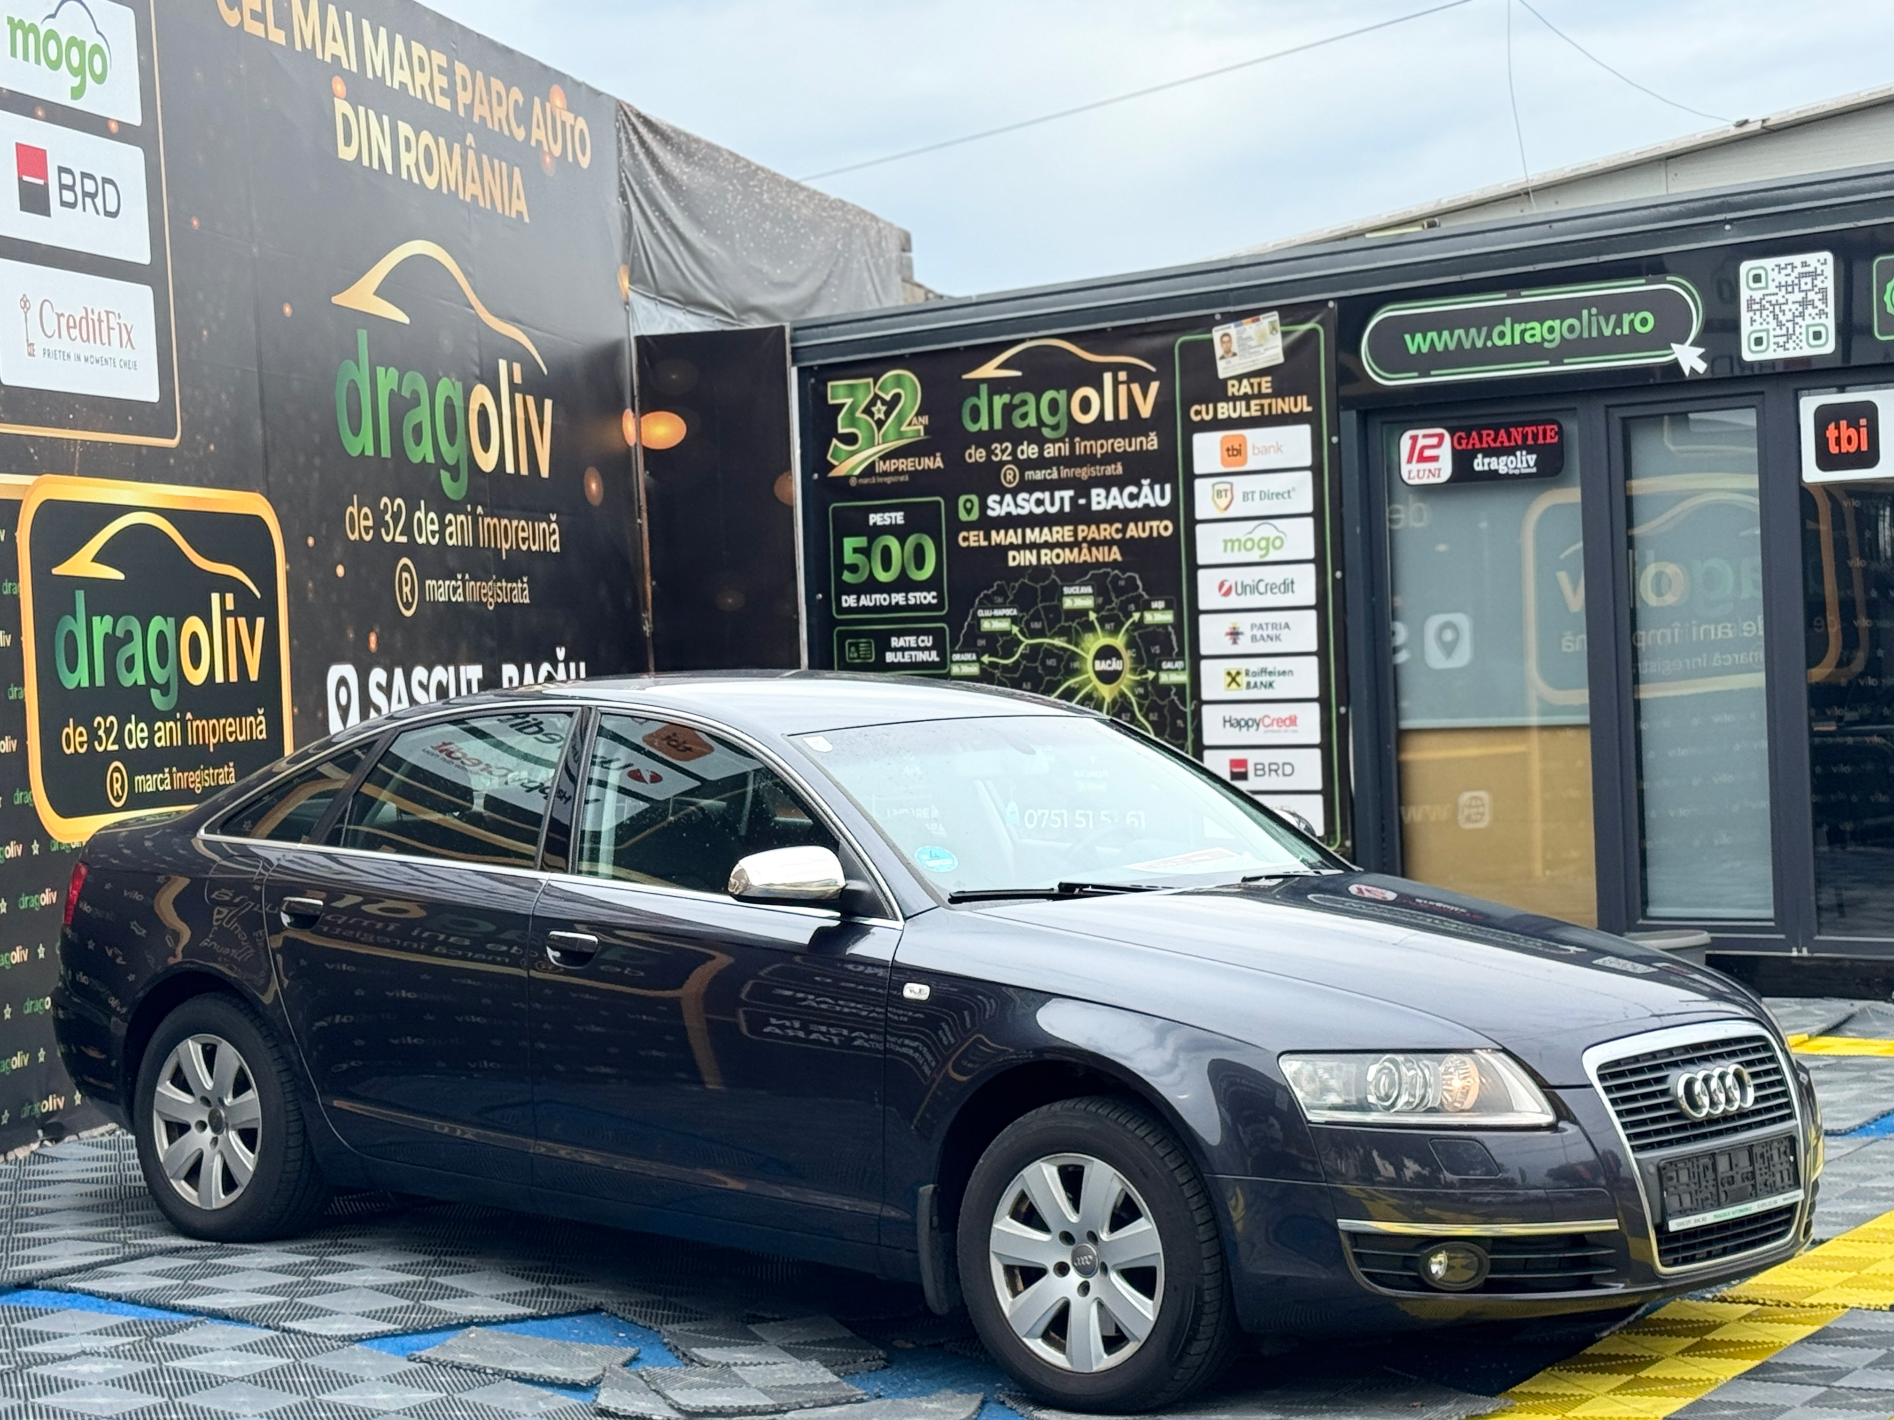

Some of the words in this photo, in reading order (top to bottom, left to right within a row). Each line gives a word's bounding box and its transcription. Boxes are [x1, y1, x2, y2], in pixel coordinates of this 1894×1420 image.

[7, 16, 108, 100] mogo
[291, 0, 358, 73] MAI
[362, 18, 451, 111] MARE
[455, 60, 526, 142] PARC
[530, 96, 591, 169] AUTO
[334, 96, 393, 175] DIN
[398, 133, 530, 223] ROMÂNIA
[57, 165, 122, 219] BRD
[39, 298, 136, 350] CreditFix
[1404, 307, 1655, 355] www.dragoliv.ro
[42, 347, 71, 361] PRIETEN
[73, 352, 81, 362] IN
[84, 354, 117, 368] MOMENTE
[119, 358, 138, 371] CHEIE
[1227, 376, 1272, 397] RATE
[335, 328, 553, 500] dragoliv
[961, 371, 1160, 439] dragoliv
[1190, 403, 1213, 422] CU
[1217, 395, 1312, 420] BULETINUL
[826, 368, 924, 466] 32
[911, 415, 929, 426] ANI
[965, 445, 987, 463] de
[991, 442, 1013, 461] 32
[1017, 441, 1039, 459] de
[1043, 439, 1070, 458] ani
[1075, 431, 1159, 457] împreună
[1452, 424, 1559, 450] GARANTIE
[1826, 418, 1869, 454] tbi
[1225, 444, 1243, 458] tbi
[1252, 441, 1283, 456] bank
[1405, 433, 1444, 465] 12
[875, 452, 944, 474] ÎMPREUNĂ
[1025, 466, 1058, 481] marcă
[1060, 462, 1123, 481] înregistrată
[1407, 467, 1442, 481] LUNI
[1473, 451, 1538, 474] dragoliv
[986, 489, 1074, 517] SASCUT
[1090, 479, 1172, 511] BACĂU
[1216, 489, 1230, 500] BT
[1242, 491, 1256, 502] BT
[345, 494, 374, 543] de
[380, 495, 408, 544] 32
[413, 499, 440, 546] de
[445, 502, 474, 548] ani
[477, 503, 561, 561] împreună
[869, 512, 904, 526] PESTE
[958, 531, 988, 547] CEL
[991, 528, 1023, 546] MAI
[1025, 526, 1075, 544] MARE
[1078, 523, 1123, 541] PARC
[1125, 520, 1173, 539] AUTO
[1008, 550, 1038, 567] DIN
[1040, 543, 1122, 566] ROMÂNIA
[1222, 534, 1284, 559] mogo
[841, 533, 937, 584] 500
[425, 573, 464, 603] marcă
[465, 575, 531, 611] înregistrată
[1063, 586, 1093, 595] SUCEAVA
[1234, 578, 1295, 596] UniCredit
[841, 595, 857, 607] DE
[859, 594, 889, 606] AUTO
[891, 593, 905, 605] PE
[906, 592, 938, 604] STOC
[977, 608, 1018, 617] CLUJ-NAPOCA
[1250, 622, 1290, 632] PATRIA
[1250, 633, 1282, 643] BANK
[54, 589, 266, 711] dragoliv
[891, 636, 916, 648] RATE
[917, 635, 933, 647] CU
[885, 649, 940, 663] BULETINUL
[952, 653, 977, 662] ORADEA
[1094, 657, 1123, 671] BACĂU
[1244, 668, 1294, 679] Raiffeisen
[1245, 680, 1276, 690] BANK
[61, 717, 88, 755] de
[93, 714, 120, 752] 32
[124, 713, 149, 751] de
[153, 711, 182, 748] ani
[185, 707, 268, 753] împreună
[1222, 714, 1298, 732] HappyCredit
[134, 766, 171, 794] marcă
[173, 761, 236, 795] înregistrată
[1254, 762, 1295, 777] BRD
[1025, 809, 1068, 830] 0751
[1074, 810, 1093, 829] 51
[18, 888, 58, 911] dragoliv
[23, 995, 51, 1015] drago
[21, 1093, 65, 1120] dragoliv
